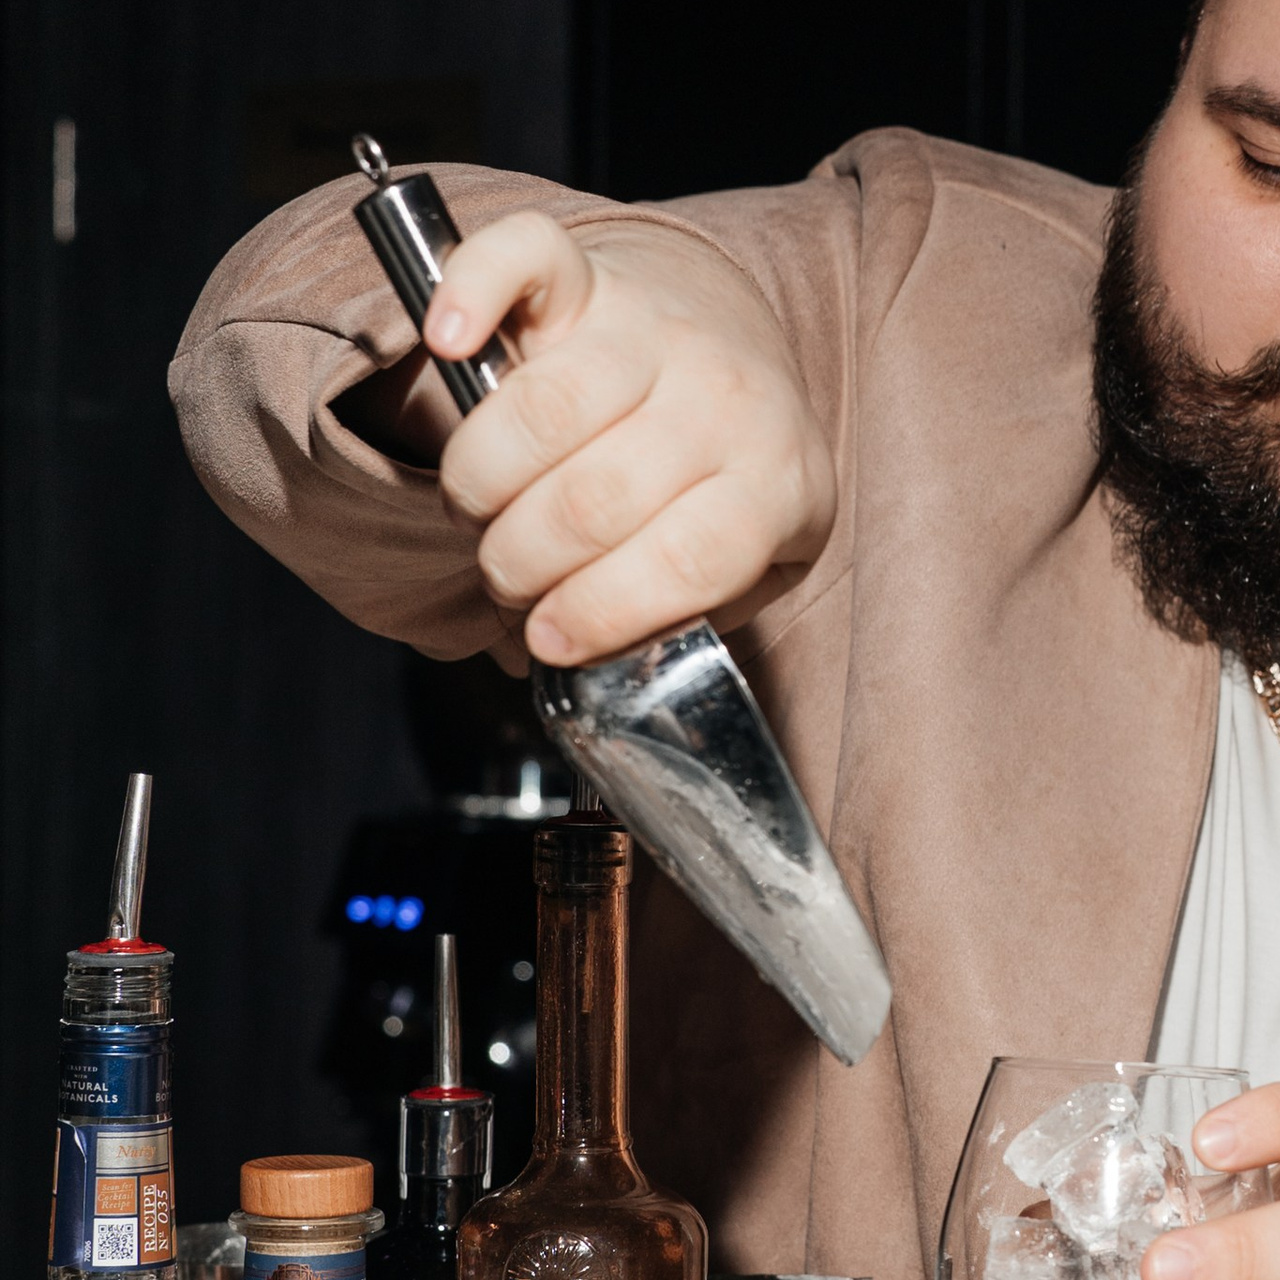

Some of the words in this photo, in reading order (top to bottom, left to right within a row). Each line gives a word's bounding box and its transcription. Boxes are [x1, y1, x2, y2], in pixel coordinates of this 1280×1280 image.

[60, 1092, 118, 1103] OTANICALS
[144, 1184, 156, 1253] RECIPE
[158, 1189, 168, 1224] 035
